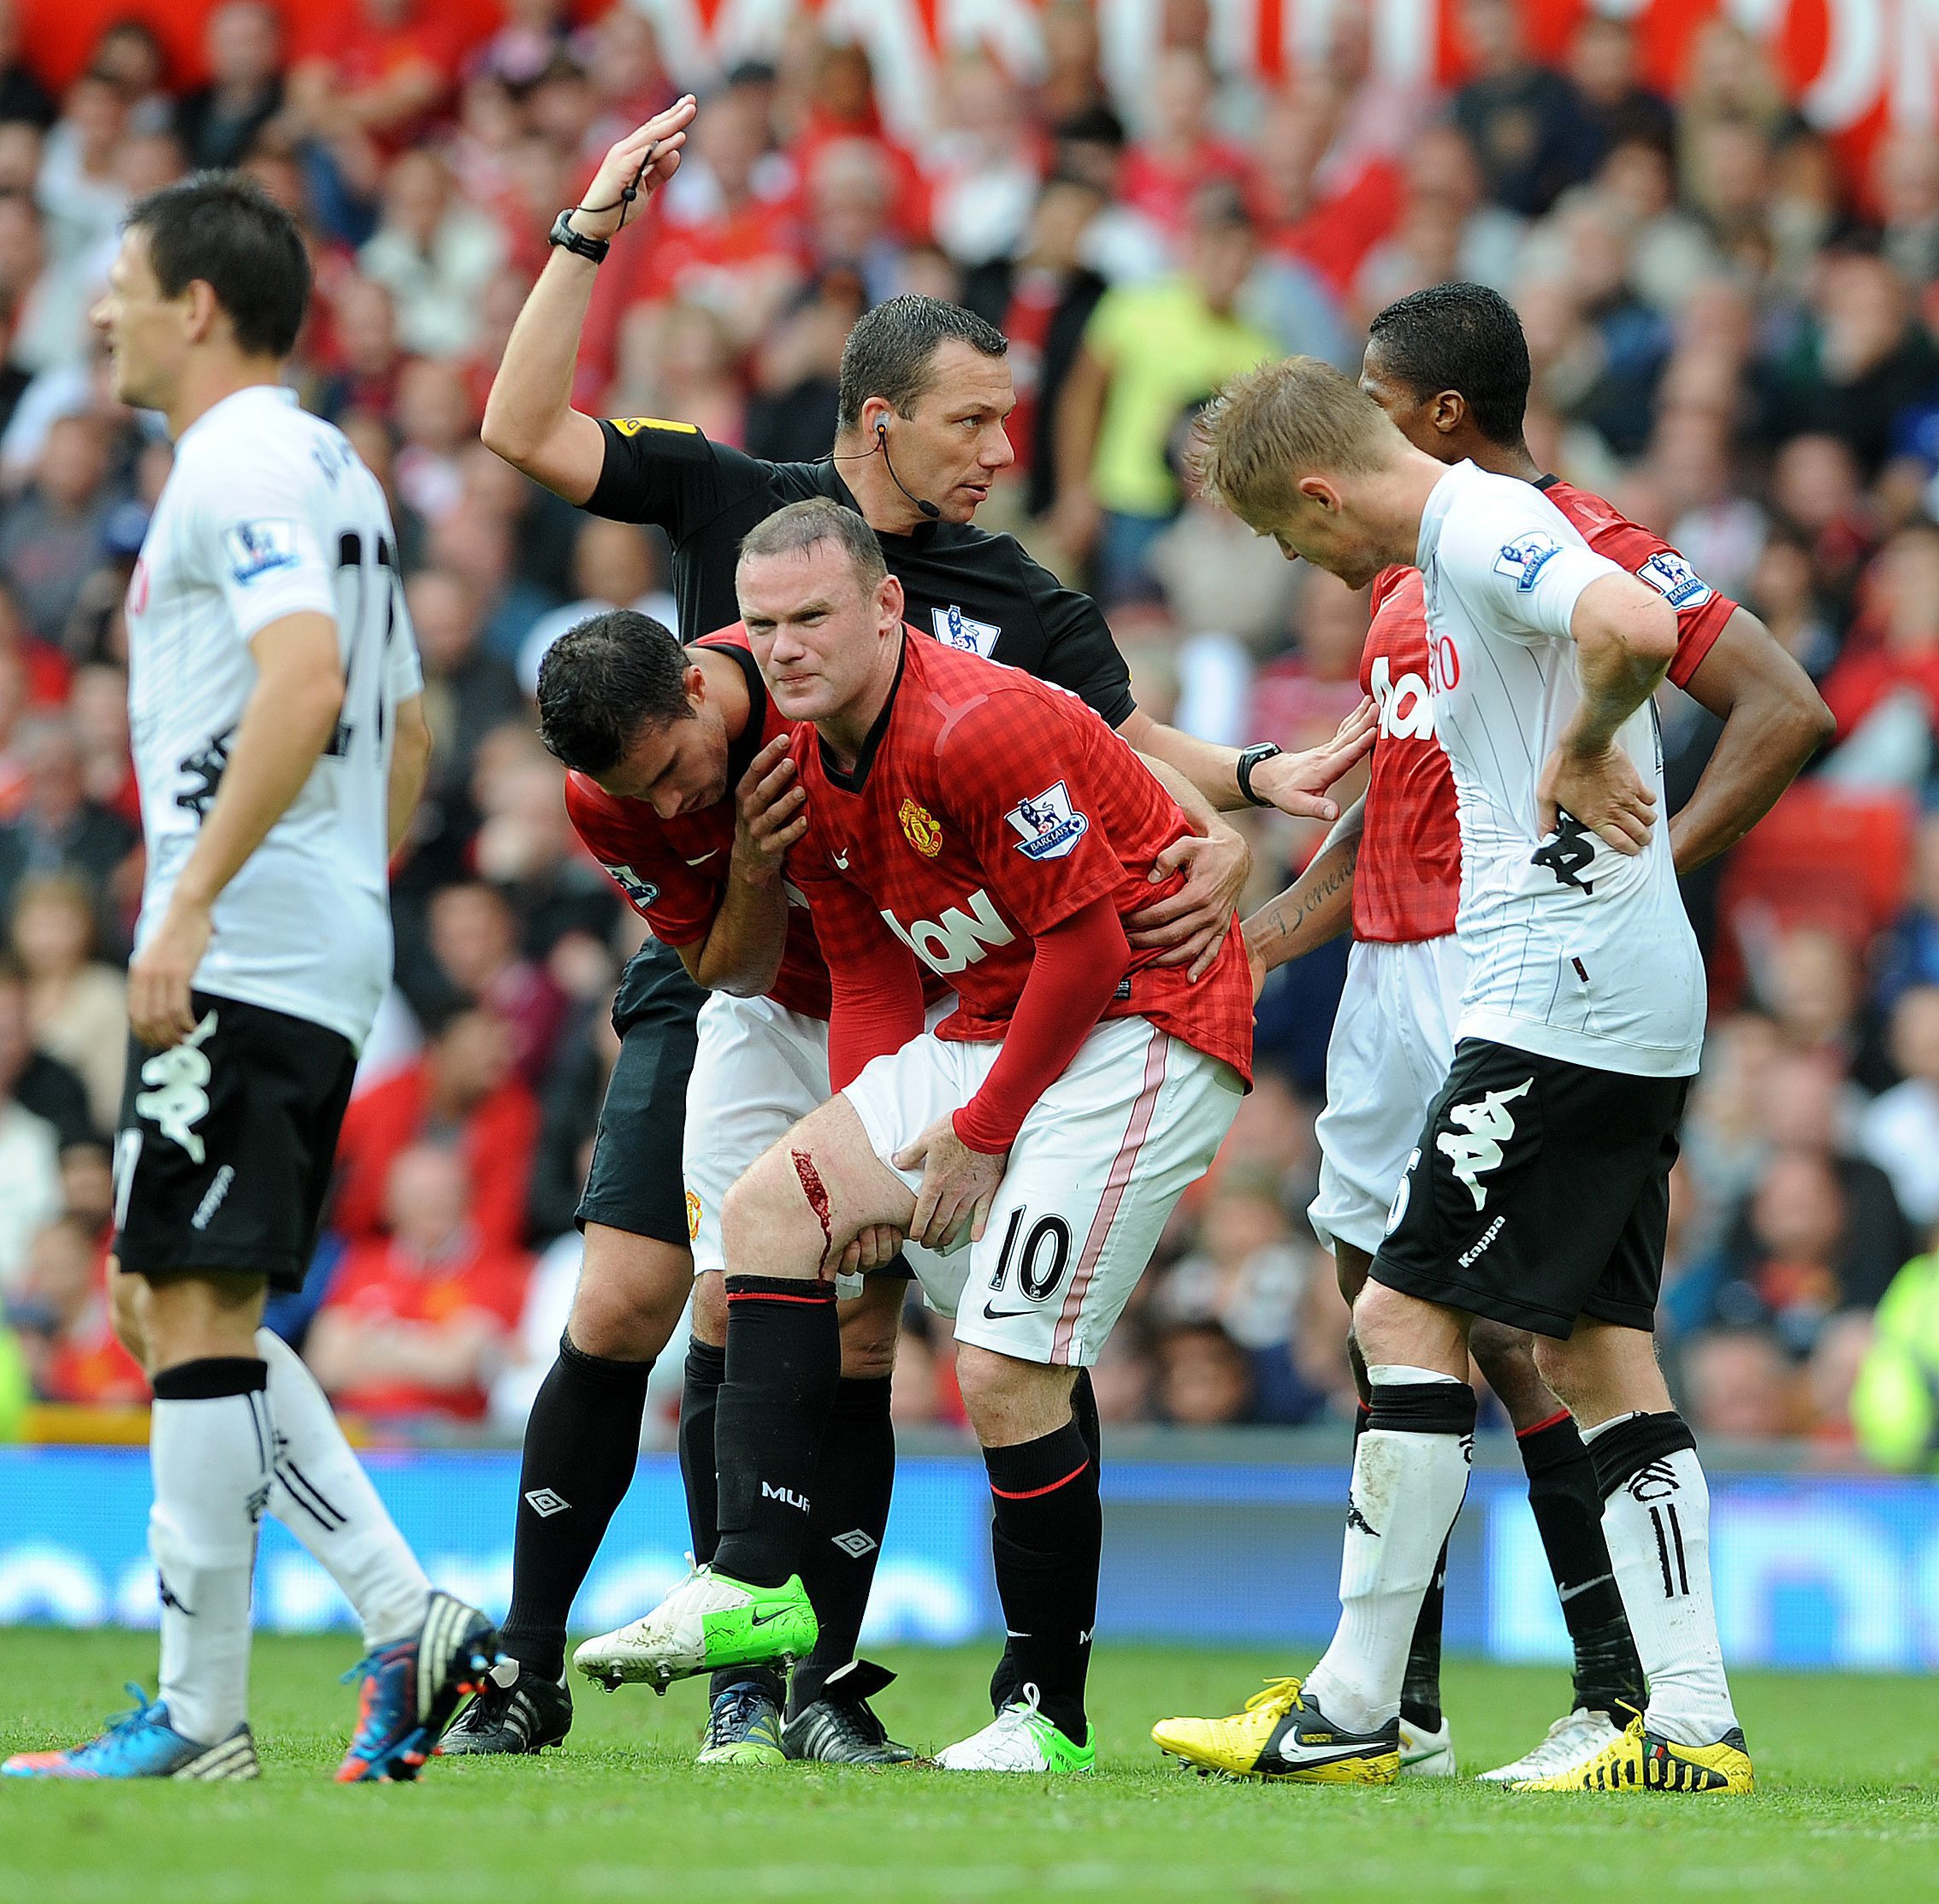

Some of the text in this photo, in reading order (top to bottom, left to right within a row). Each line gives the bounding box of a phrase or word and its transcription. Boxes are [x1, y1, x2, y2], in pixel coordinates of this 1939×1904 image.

[1030, 825, 1069, 851] BARCLAYS
[989, 1203, 1073, 1303] 10
[1457, 1215, 1506, 1268] Kappa
